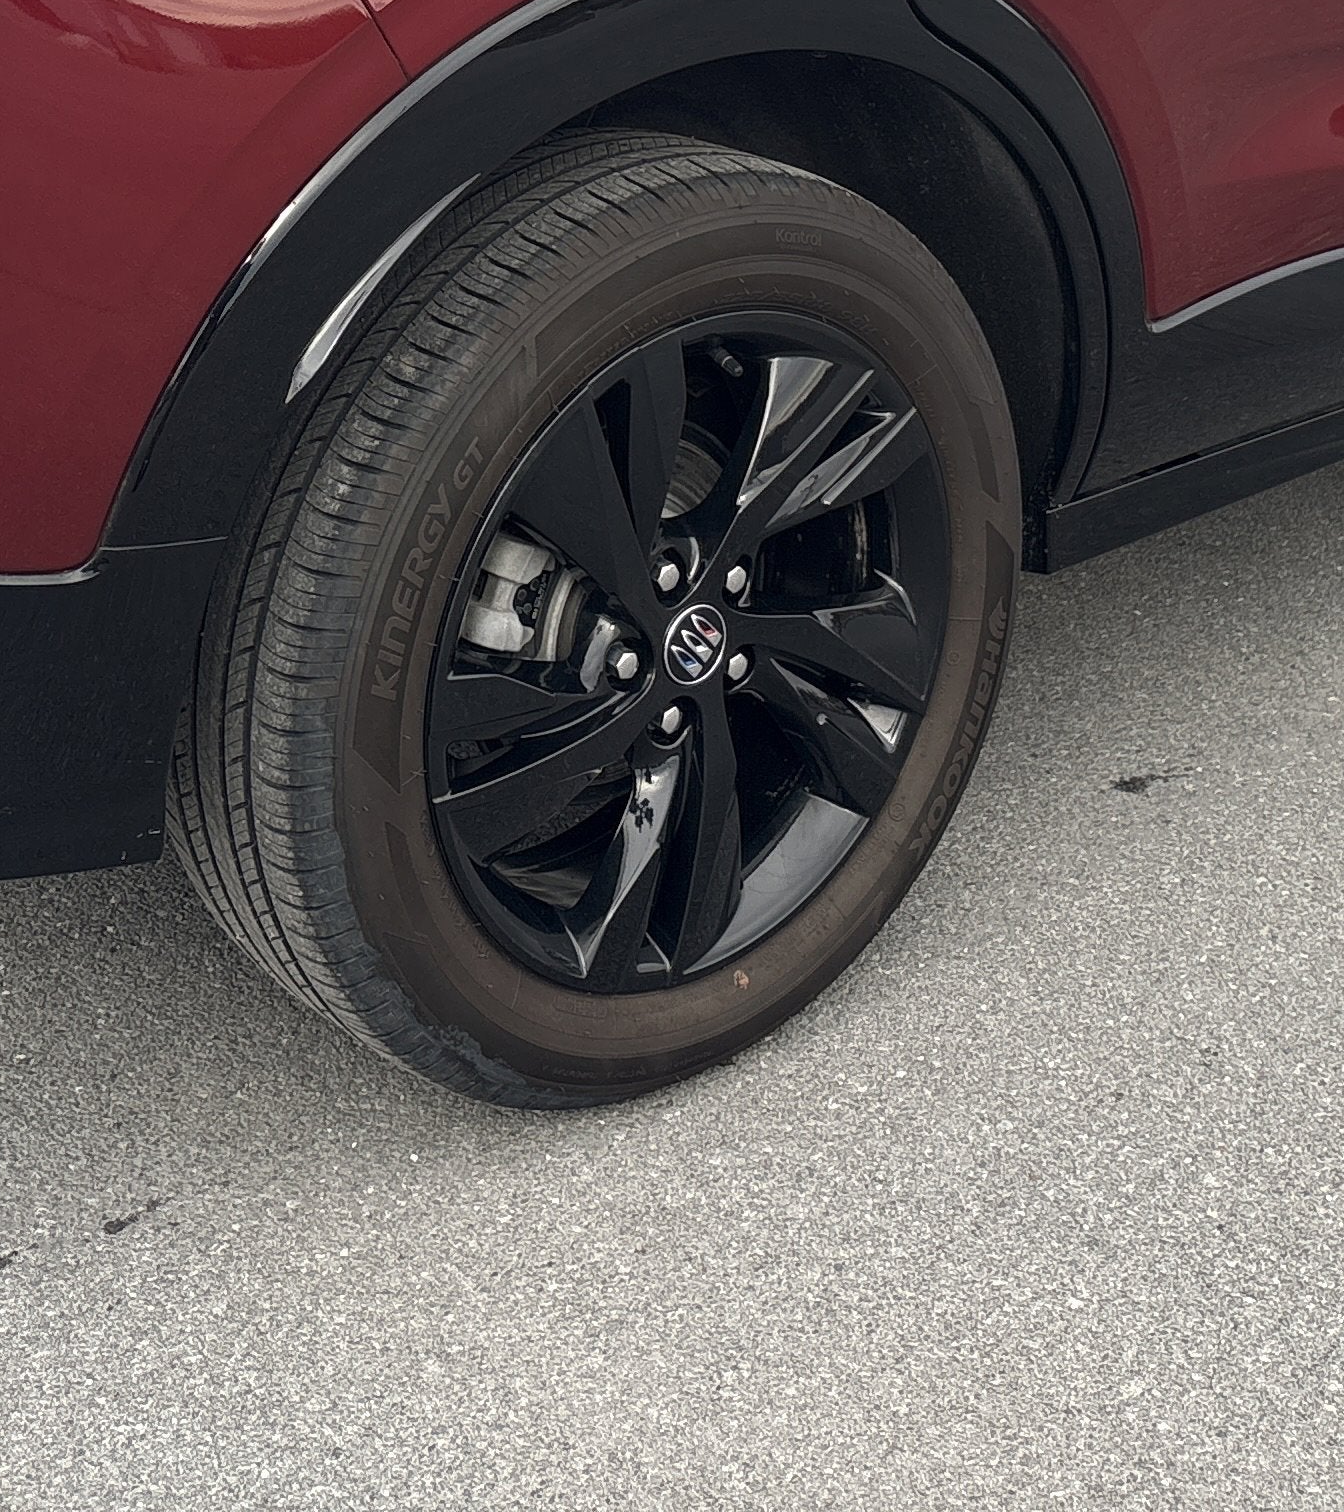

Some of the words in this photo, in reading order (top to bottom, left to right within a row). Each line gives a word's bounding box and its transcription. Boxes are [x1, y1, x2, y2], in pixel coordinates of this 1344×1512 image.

[776, 228, 823, 247] Kontrol
[371, 483, 452, 701] KINERGY
[453, 436, 484, 486] GT
